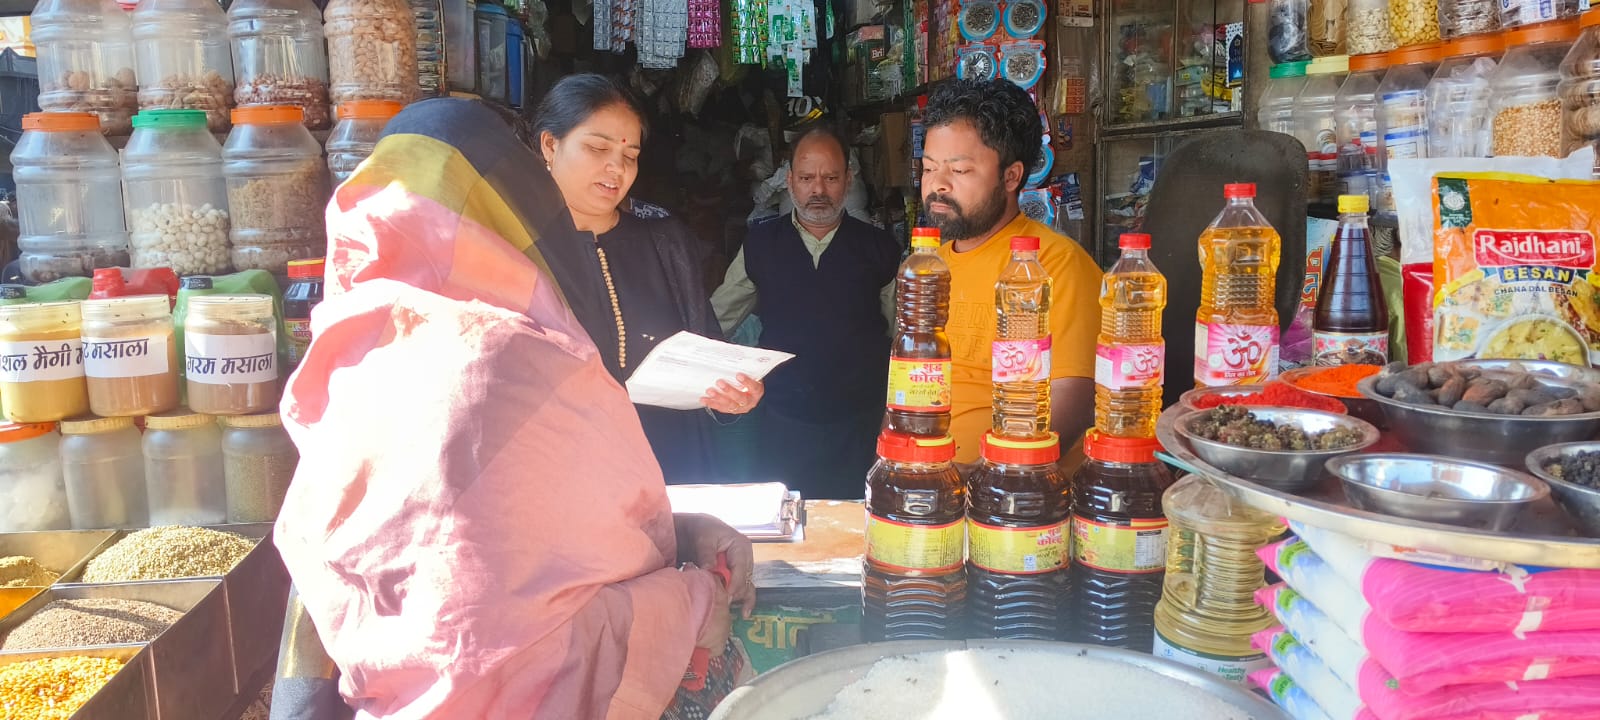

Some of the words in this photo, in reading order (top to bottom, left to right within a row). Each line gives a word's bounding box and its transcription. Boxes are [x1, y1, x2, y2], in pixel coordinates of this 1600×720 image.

[1480, 235, 1583, 258] Rajdhani
[1503, 267, 1570, 282] BESAN
[1495, 285, 1527, 296] CHANA
[1529, 284, 1547, 293] DAL
[1548, 286, 1578, 297] BESAN
[33, 343, 73, 370] मैगी
[92, 338, 149, 359] मसाला
[187, 356, 217, 375] गरम
[221, 352, 273, 374] मसाला
[908, 371, 948, 386] कोल्हू
